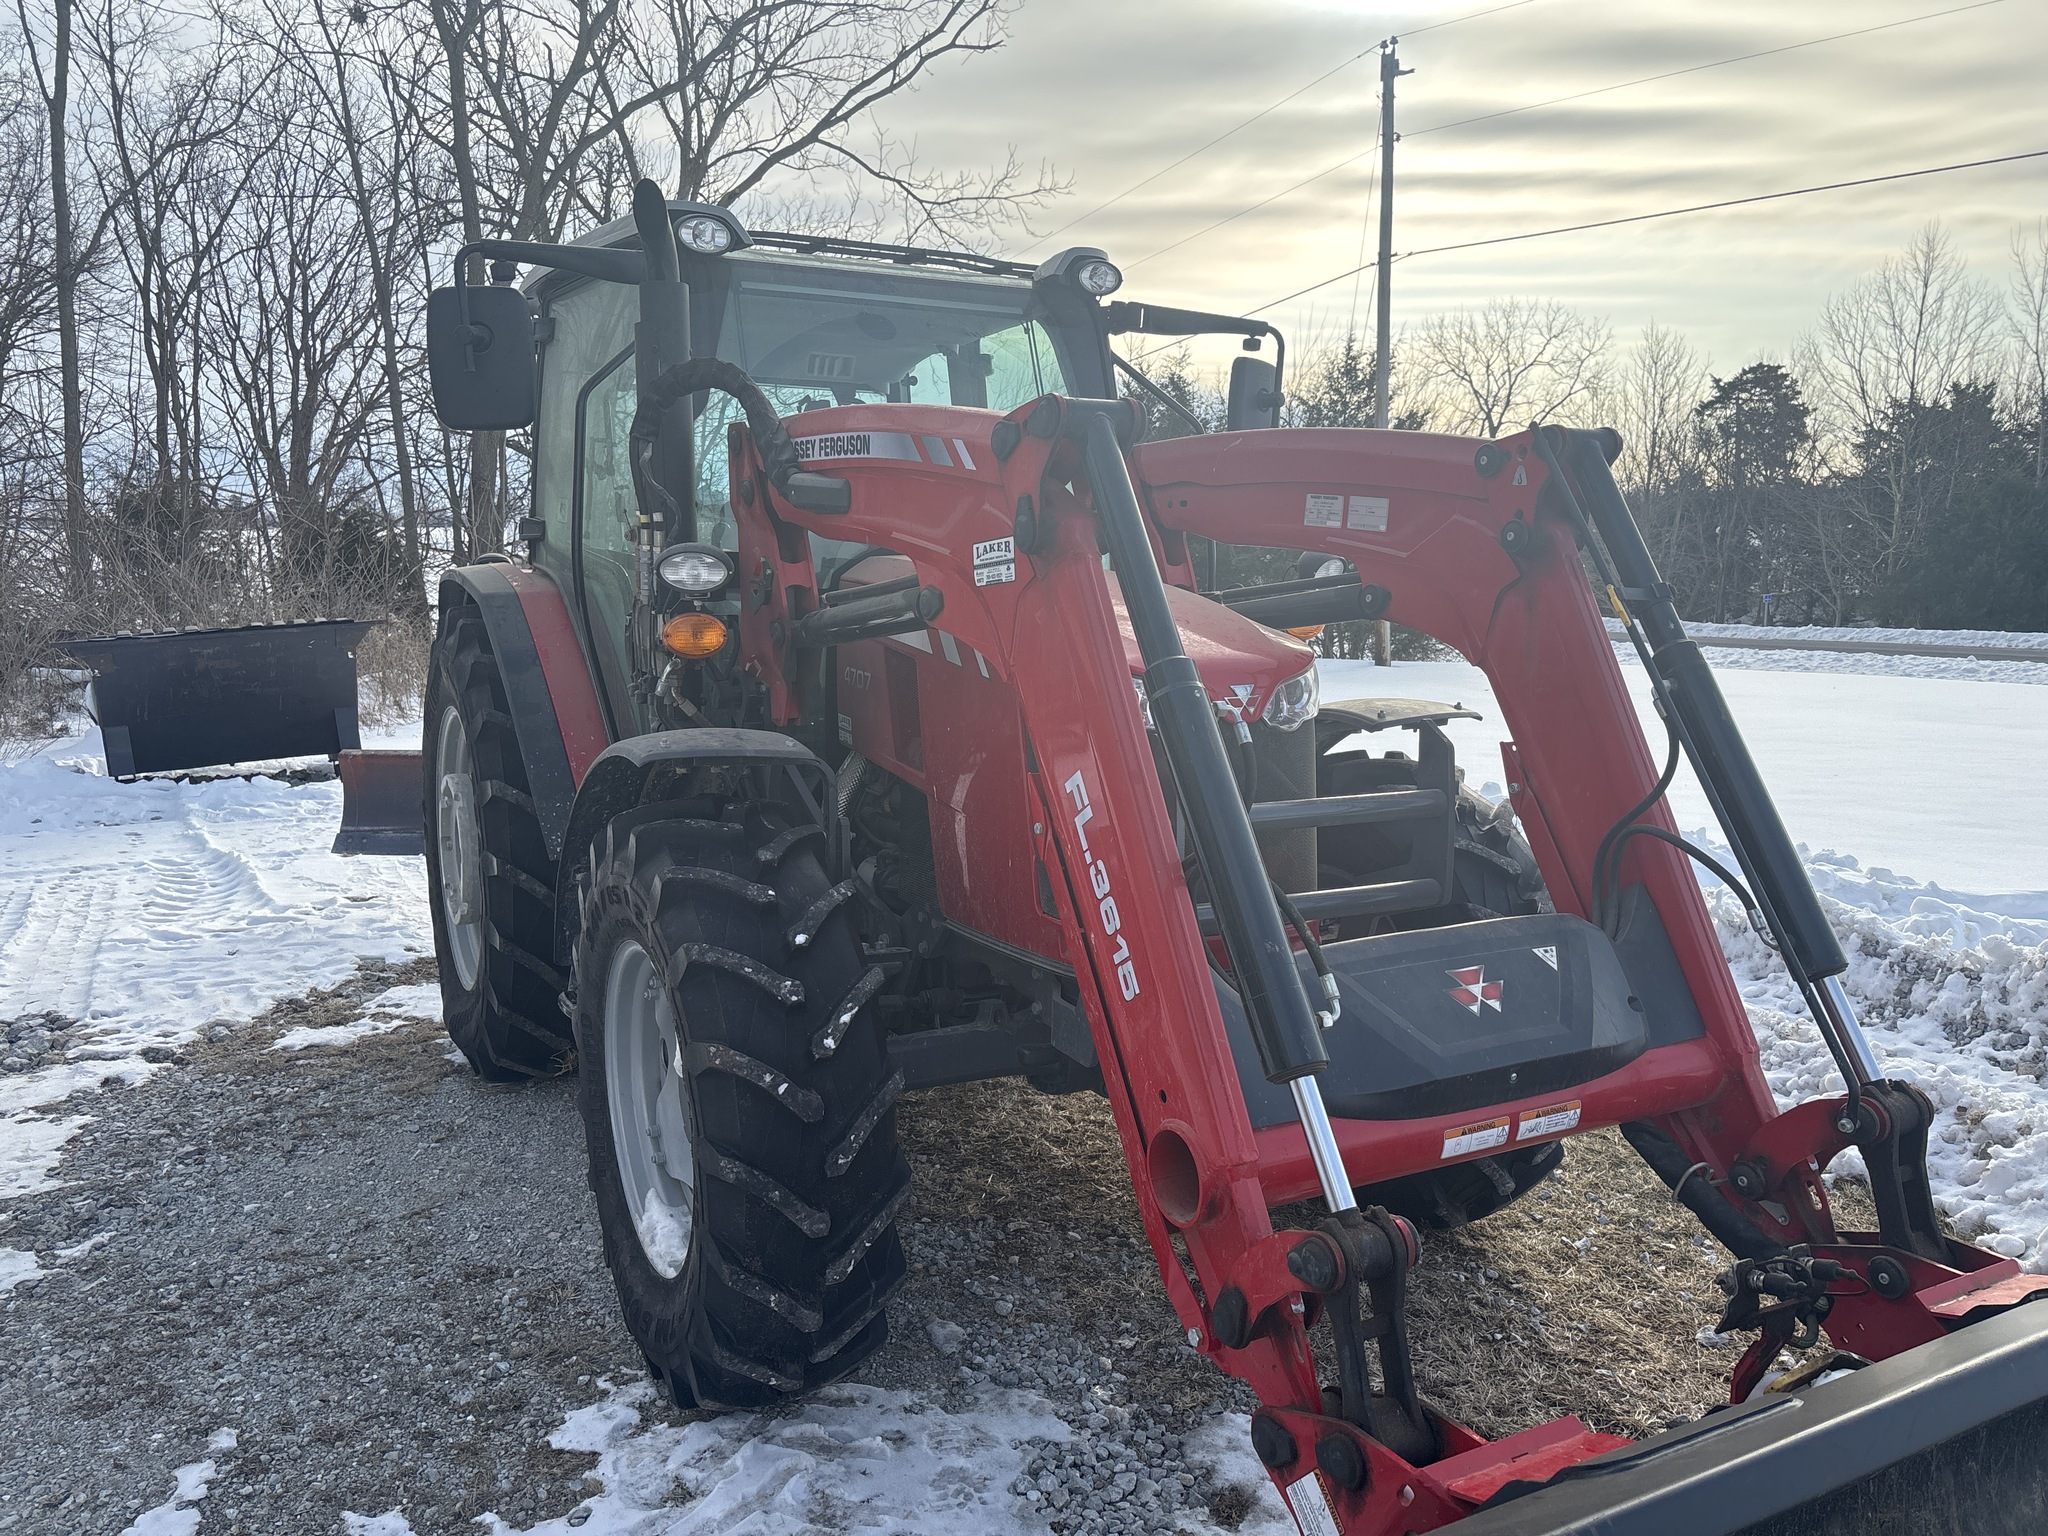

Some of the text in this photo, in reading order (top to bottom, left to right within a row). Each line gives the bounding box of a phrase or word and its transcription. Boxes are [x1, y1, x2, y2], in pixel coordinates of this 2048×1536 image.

[791, 434, 871, 459] SSEY FERGUSON
[975, 540, 1012, 560] LAKER
[844, 666, 872, 691] 4707
[1541, 1104, 1569, 1118] WARNING
[1467, 1121, 1497, 1136] WARNING
[1319, 1481, 1345, 1535] WARNING
